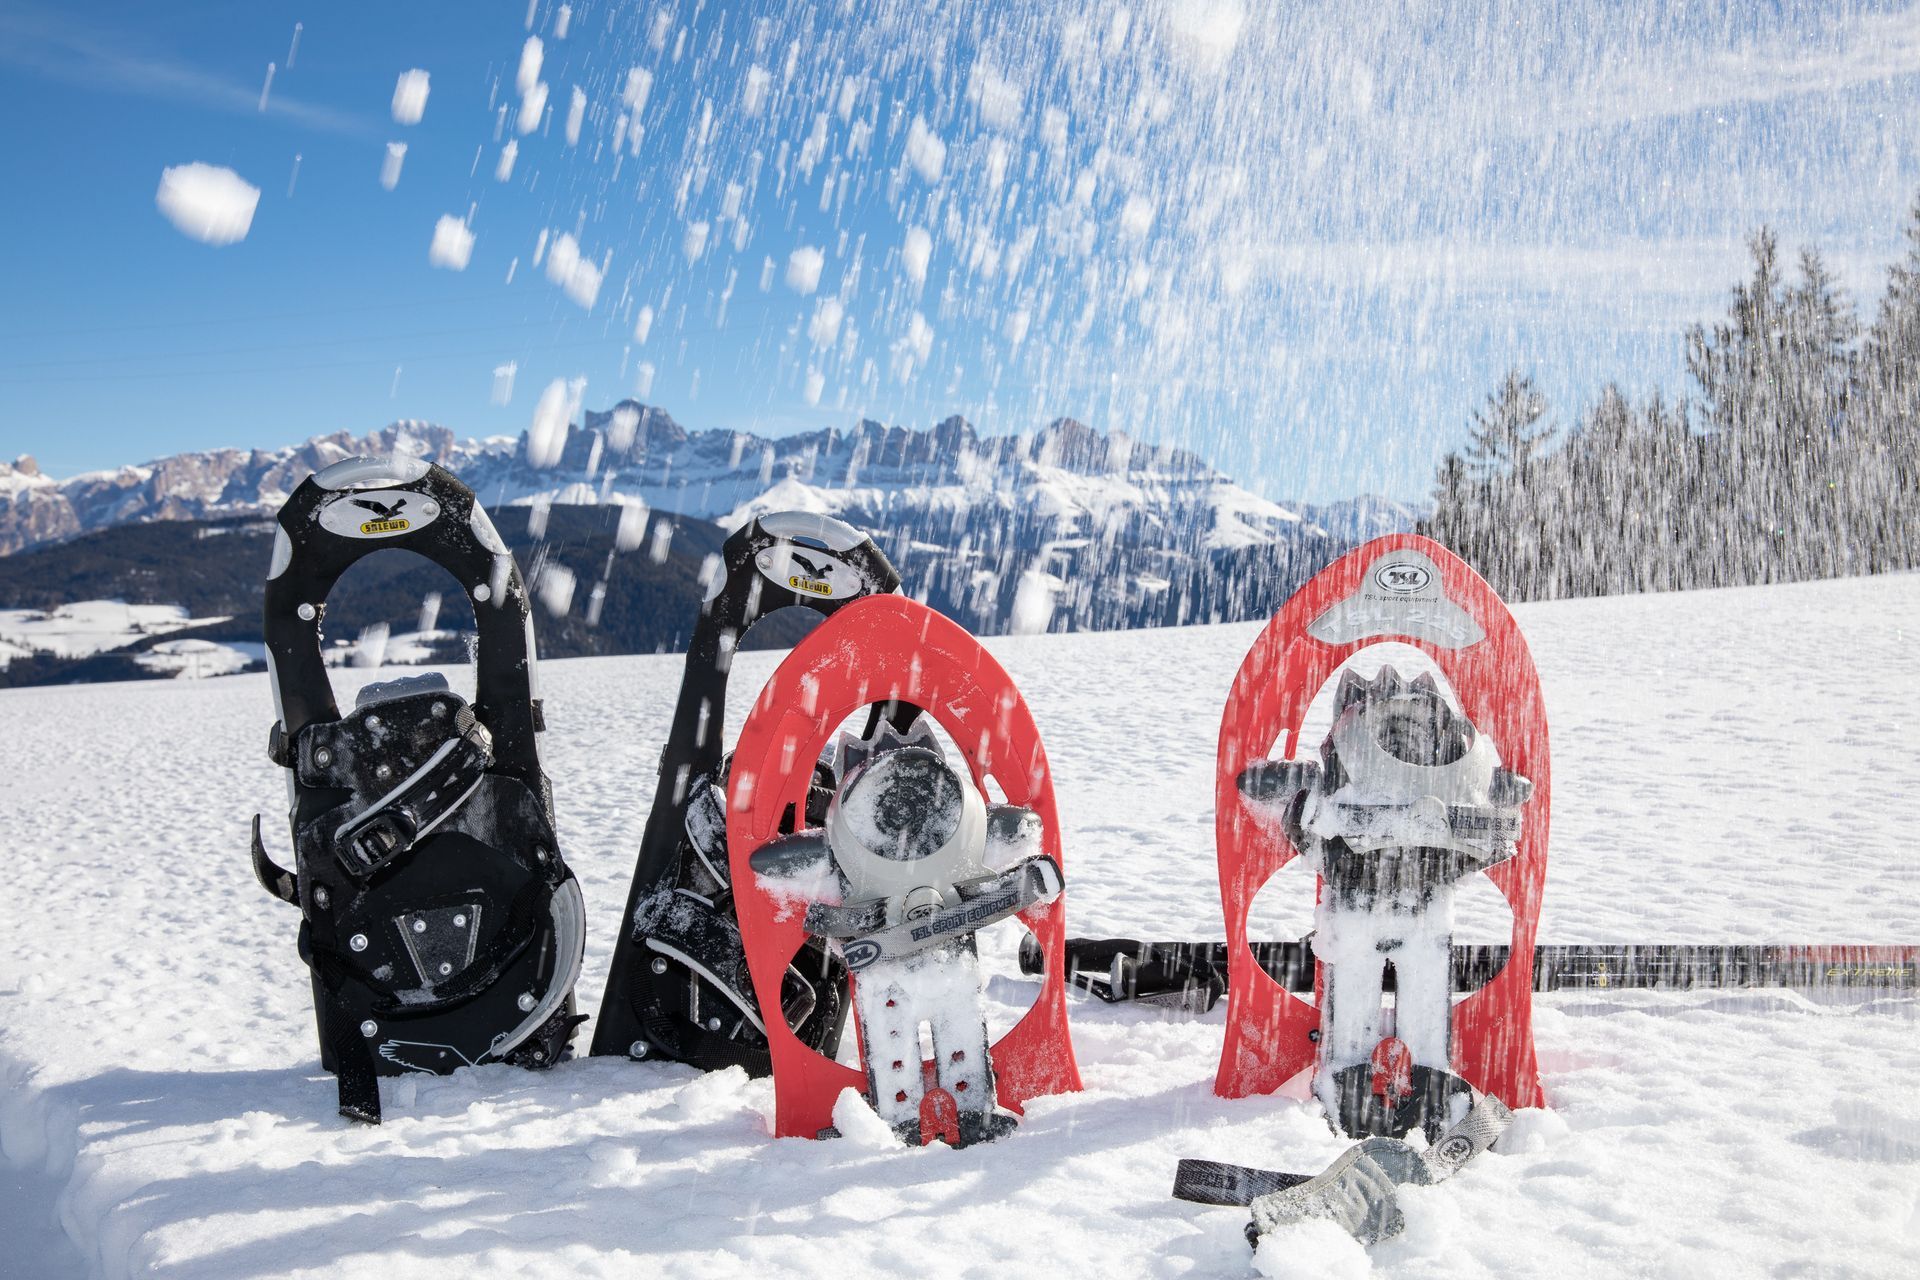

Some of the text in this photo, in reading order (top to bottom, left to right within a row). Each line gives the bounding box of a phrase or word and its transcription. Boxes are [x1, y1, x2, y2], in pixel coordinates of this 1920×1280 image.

[365, 520, 405, 532] SALEWA
[1388, 571, 1420, 585] TSL
[793, 578, 829, 593] SLEWA
[911, 926, 932, 942] TSL
[932, 912, 967, 935] SPORT
